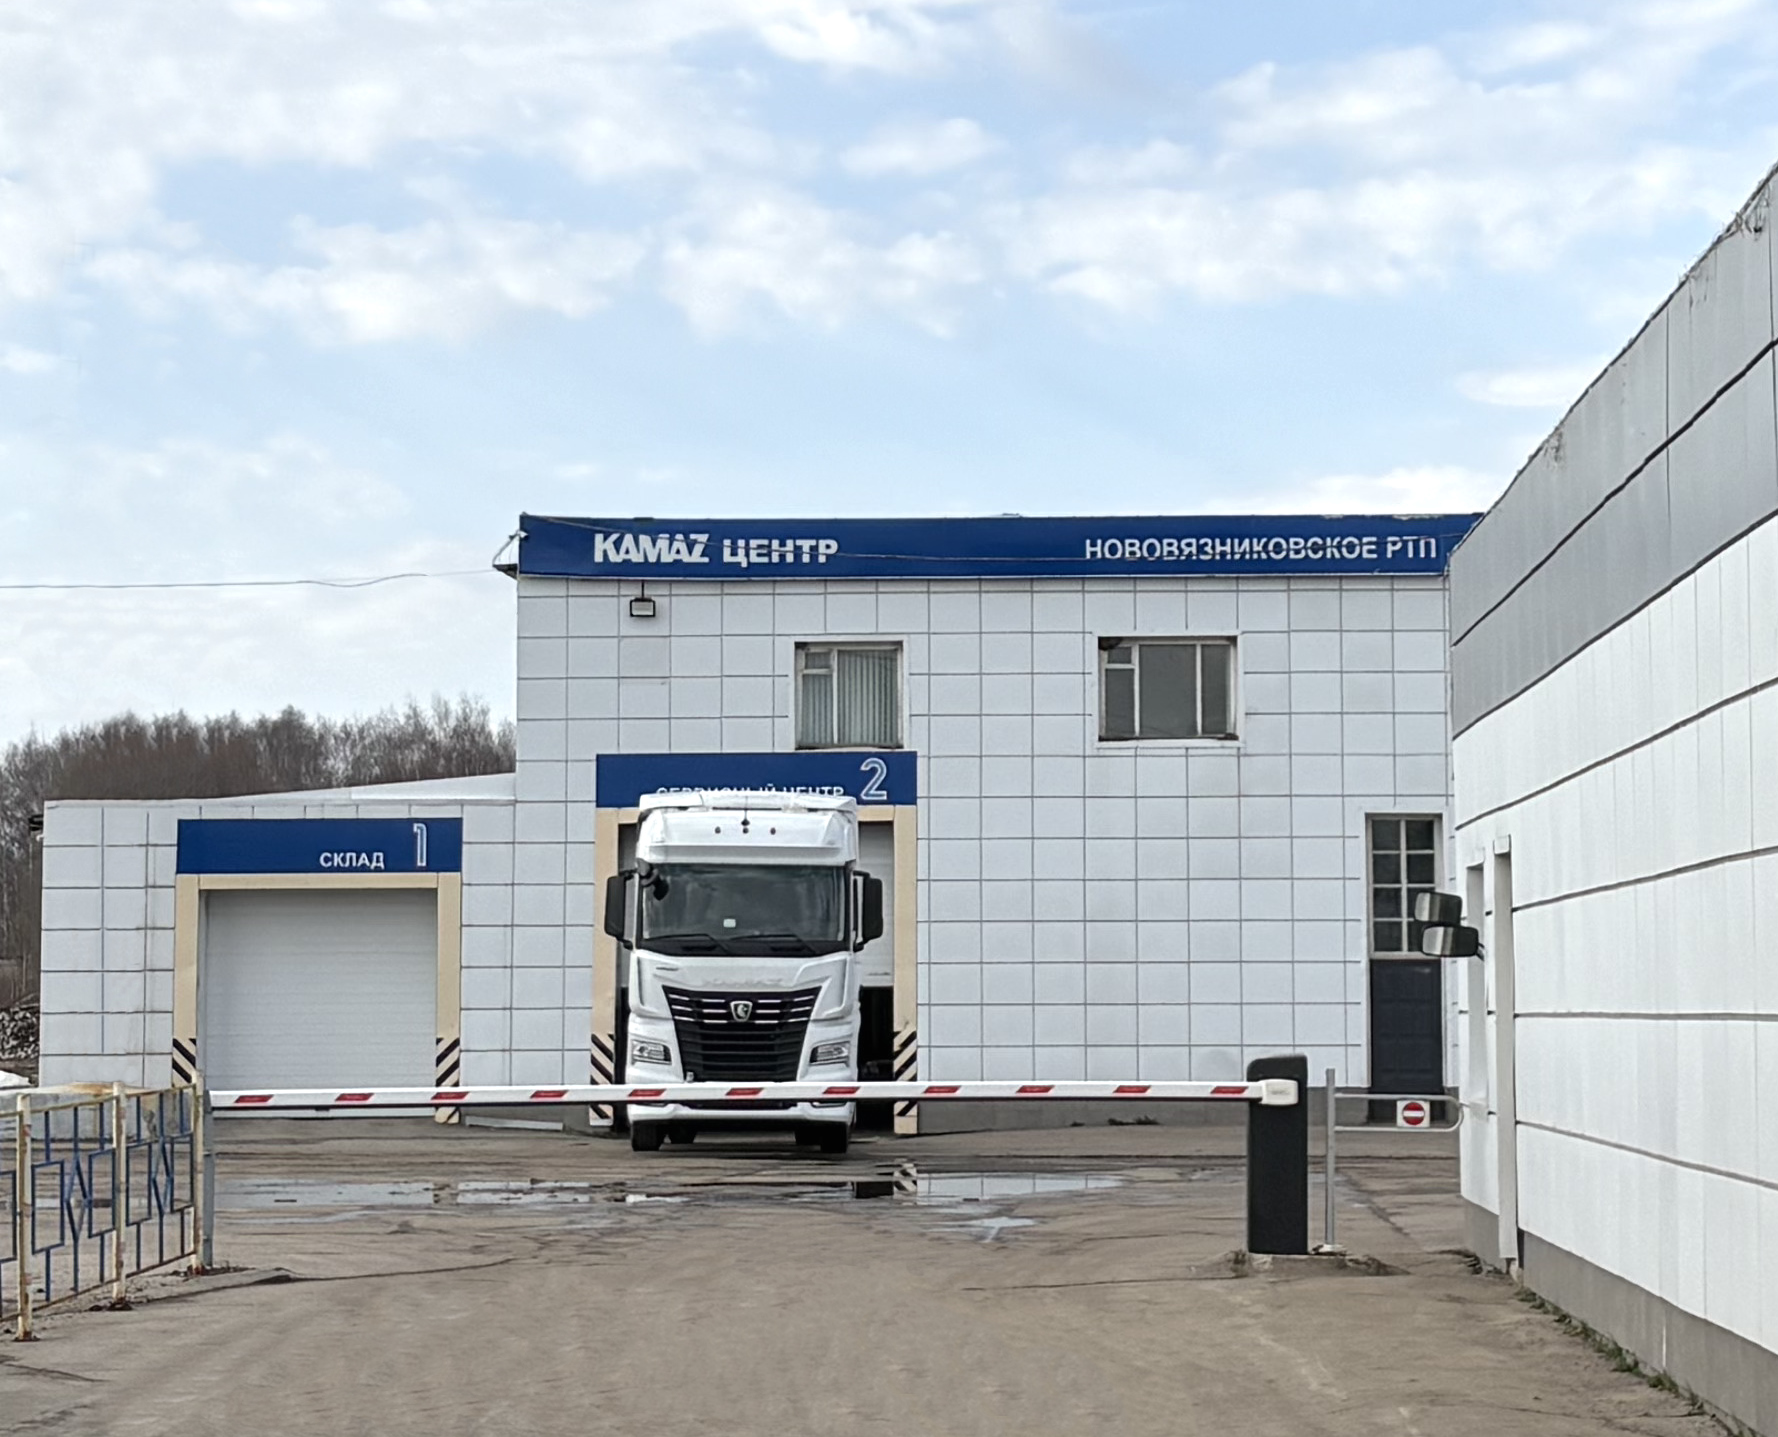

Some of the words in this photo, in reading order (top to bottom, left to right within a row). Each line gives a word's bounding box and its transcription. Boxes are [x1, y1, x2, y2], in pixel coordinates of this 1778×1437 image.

[594, 533, 710, 563] KAMAZ
[723, 539, 839, 568] ЦЕНТР
[1085, 536, 1378, 561] НОВОВЯЗНИКОВСКОЕ
[1386, 535, 1437, 559] РТП
[859, 757, 888, 801] 2
[319, 852, 385, 869] СКЛАД
[413, 823, 428, 867] 1
